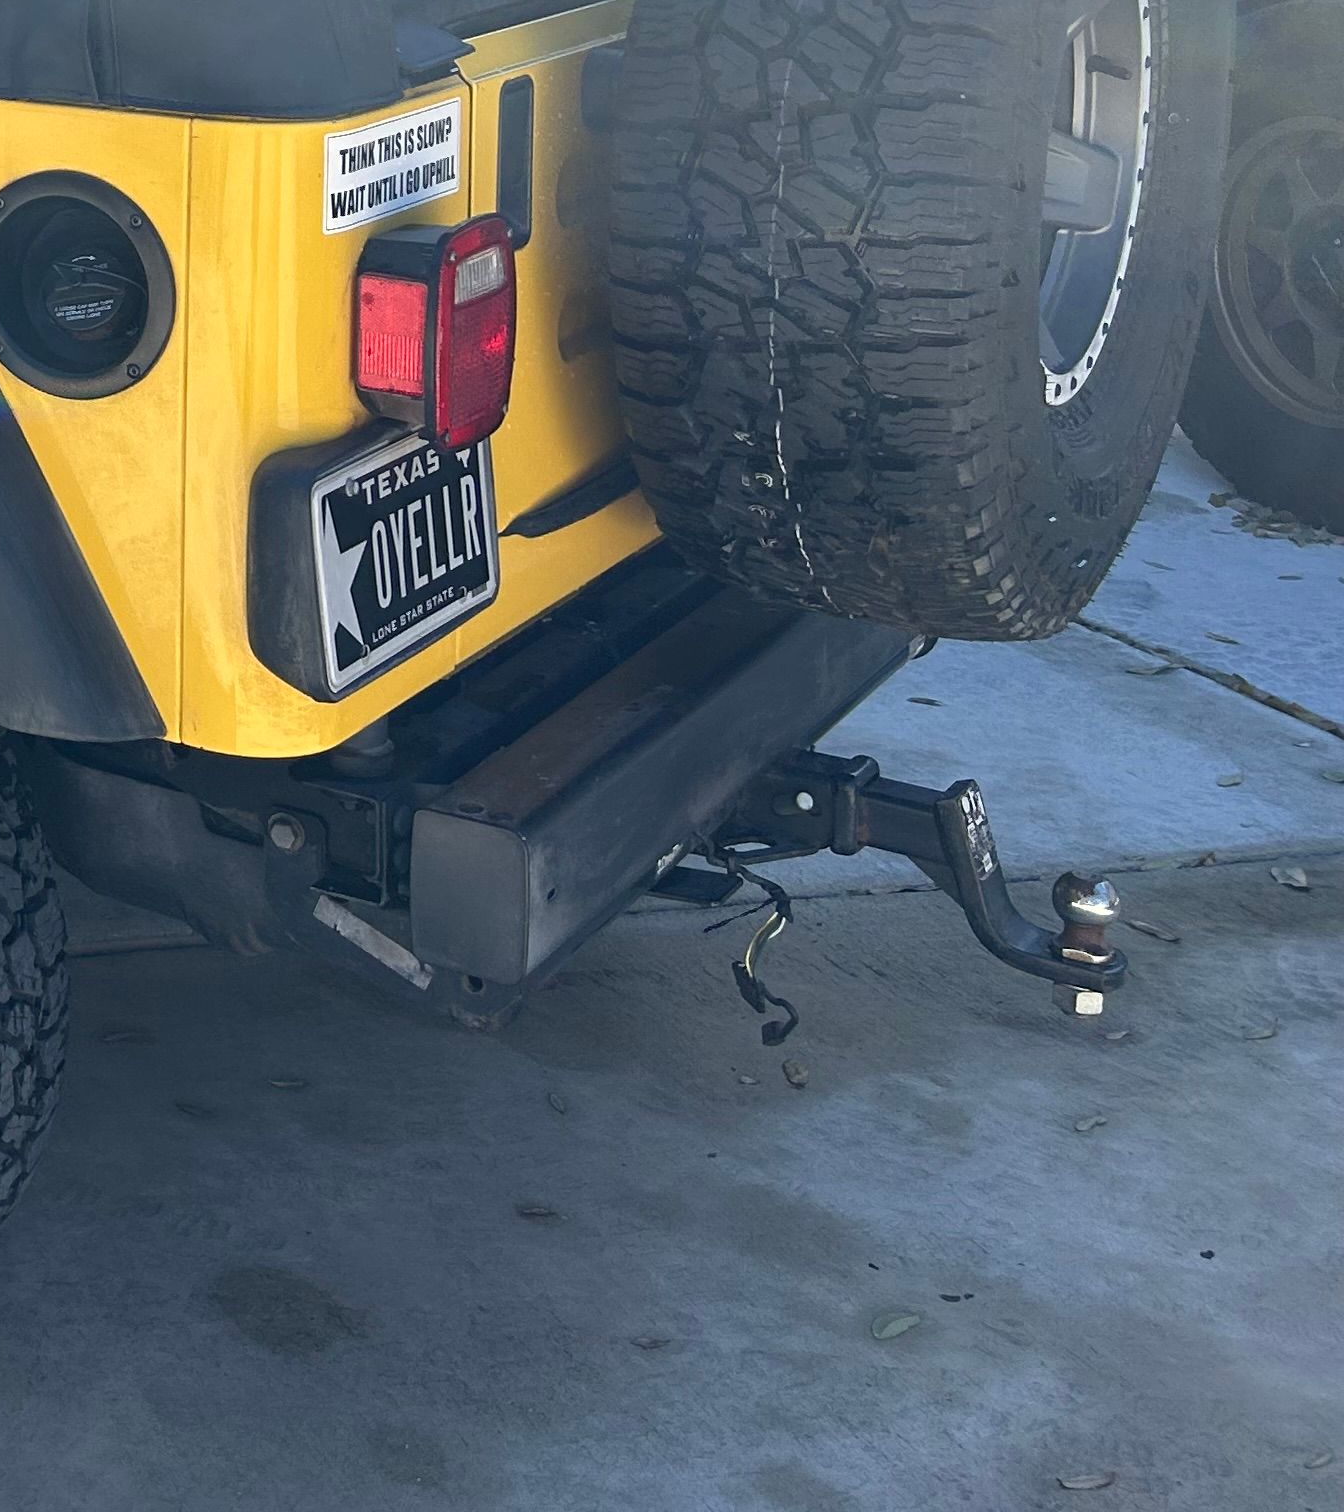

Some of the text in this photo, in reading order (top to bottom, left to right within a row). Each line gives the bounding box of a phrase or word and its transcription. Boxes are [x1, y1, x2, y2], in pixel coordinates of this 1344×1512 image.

[340, 116, 452, 175] THINK THIS IS SLOW?
[331, 155, 456, 218] WAIT UNTIL I GO UPHILL
[362, 448, 440, 505] TEXAS
[372, 586, 455, 643] LONE STAR STATE
